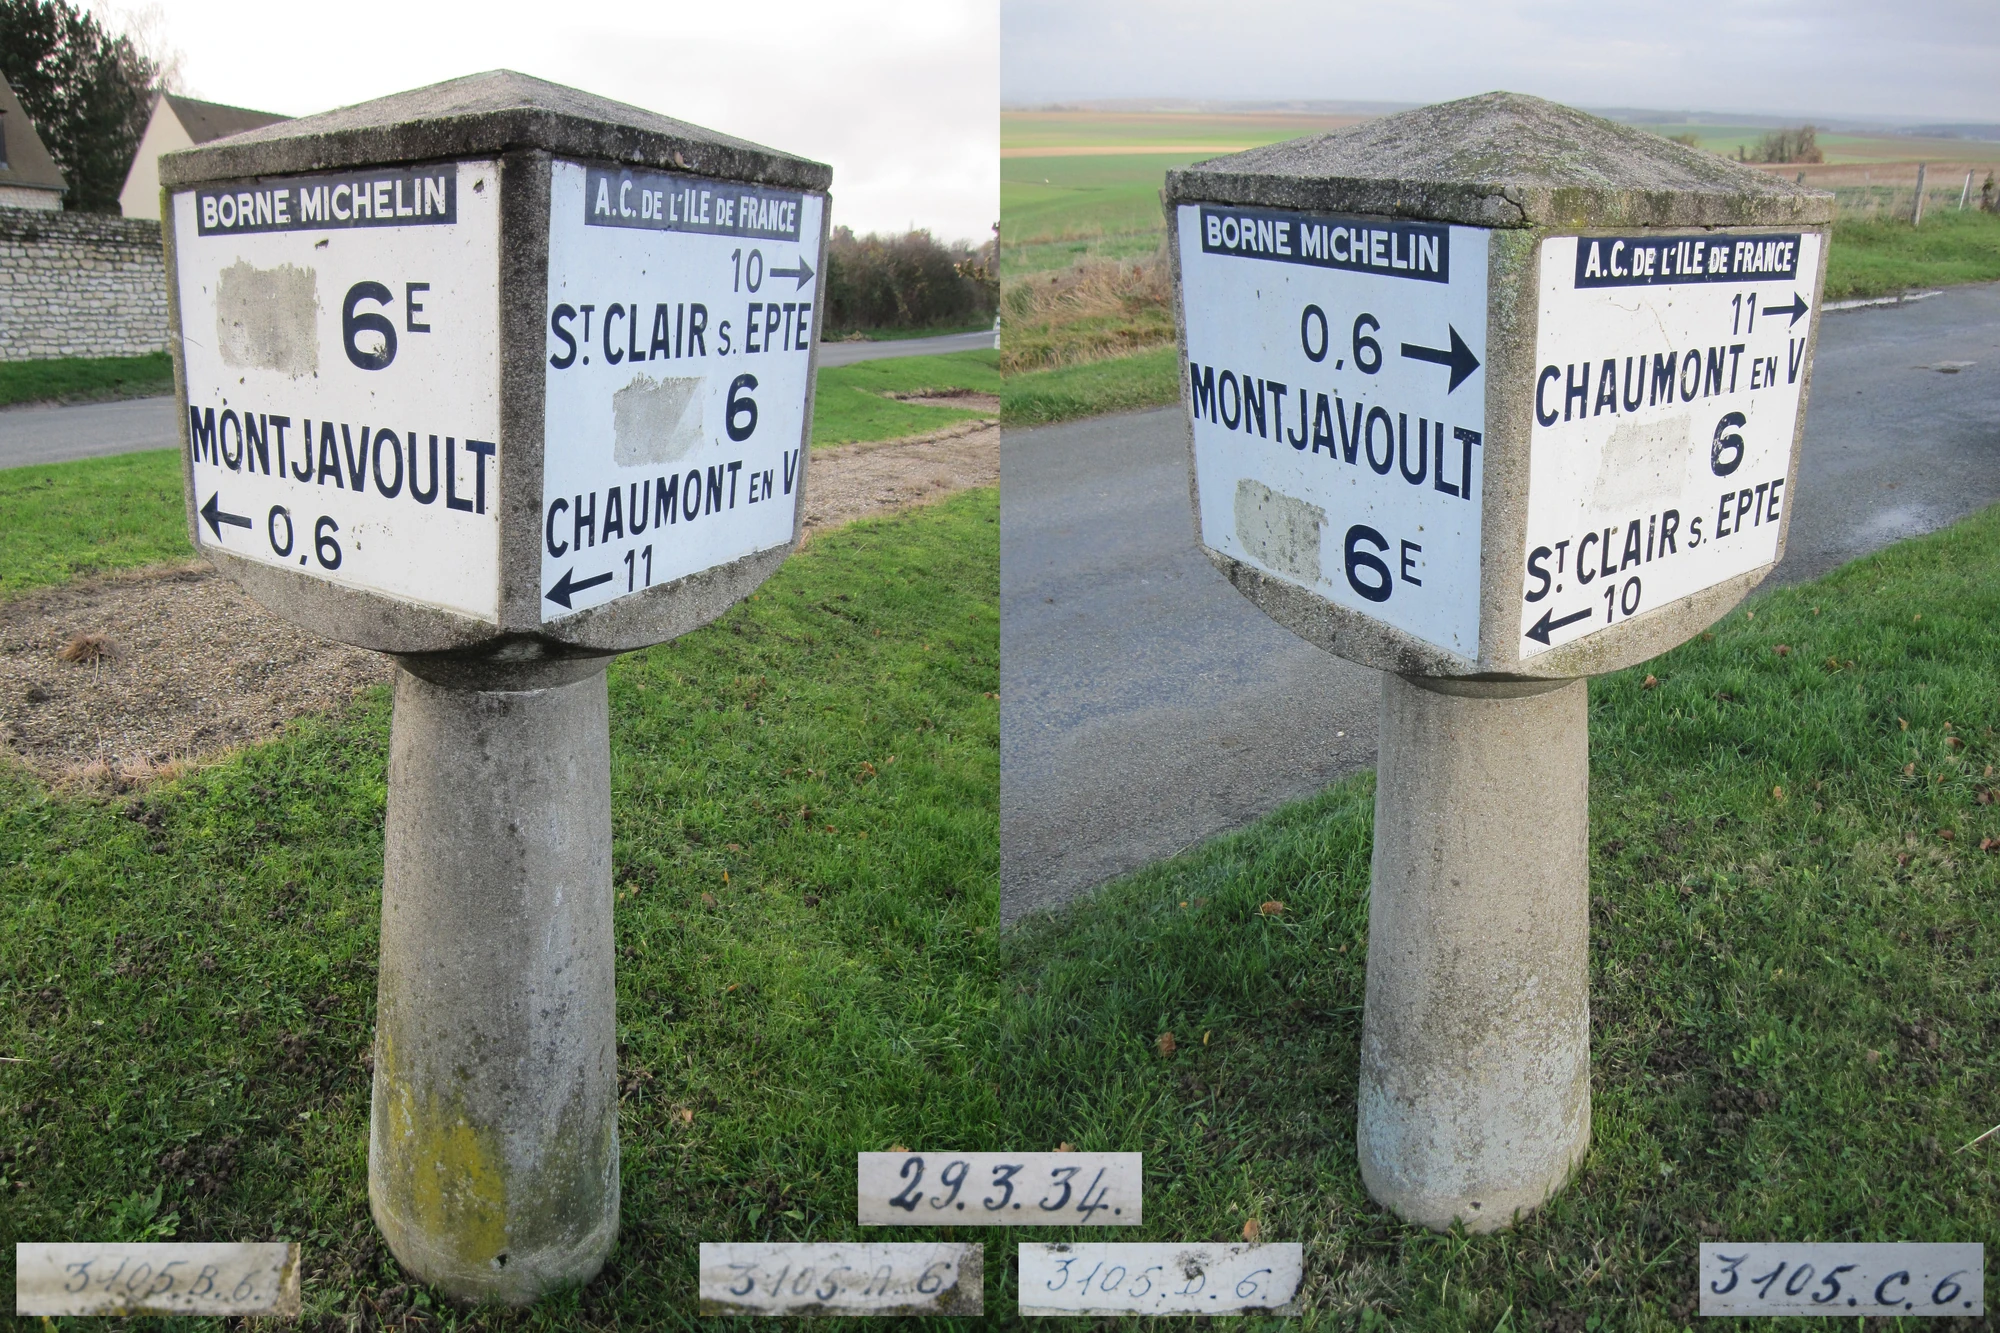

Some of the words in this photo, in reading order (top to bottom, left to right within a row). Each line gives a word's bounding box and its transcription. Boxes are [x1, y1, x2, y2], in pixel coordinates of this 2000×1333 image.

[203, 189, 291, 228] BORNE
[300, 176, 446, 222] MICHELIN
[594, 177, 637, 218] A.C.
[641, 189, 663, 220] DE
[715, 197, 734, 227] DE
[739, 195, 796, 233] FRANCE
[731, 248, 763, 293] 10
[1207, 215, 1291, 255] BORNE
[1300, 223, 1439, 273] MICHELIN
[1584, 240, 1628, 278] A.C.
[1632, 247, 1656, 276] DE
[1709, 247, 1731, 274] DE
[1733, 241, 1794, 273] FRANCE
[603, 302, 708, 366] CLAIR
[745, 302, 812, 354] EPTE
[1731, 292, 1758, 336] 11
[725, 373, 759, 443] 6
[1536, 343, 1745, 428] CHAUMONT
[1750, 356, 1778, 390] EN
[1787, 337, 1806, 385] V
[190, 404, 496, 515] MONTJAVOULT
[1190, 361, 1482, 501] MONTJAVOULT
[1710, 411, 1747, 477] 6
[545, 460, 743, 559] CHAUMONT
[748, 468, 774, 504] EN
[783, 448, 799, 496] V
[1576, 508, 1680, 585] CLAIR
[1715, 478, 1785, 540] EPTE
[624, 544, 652, 592] 11
[1604, 576, 1642, 623] 10
